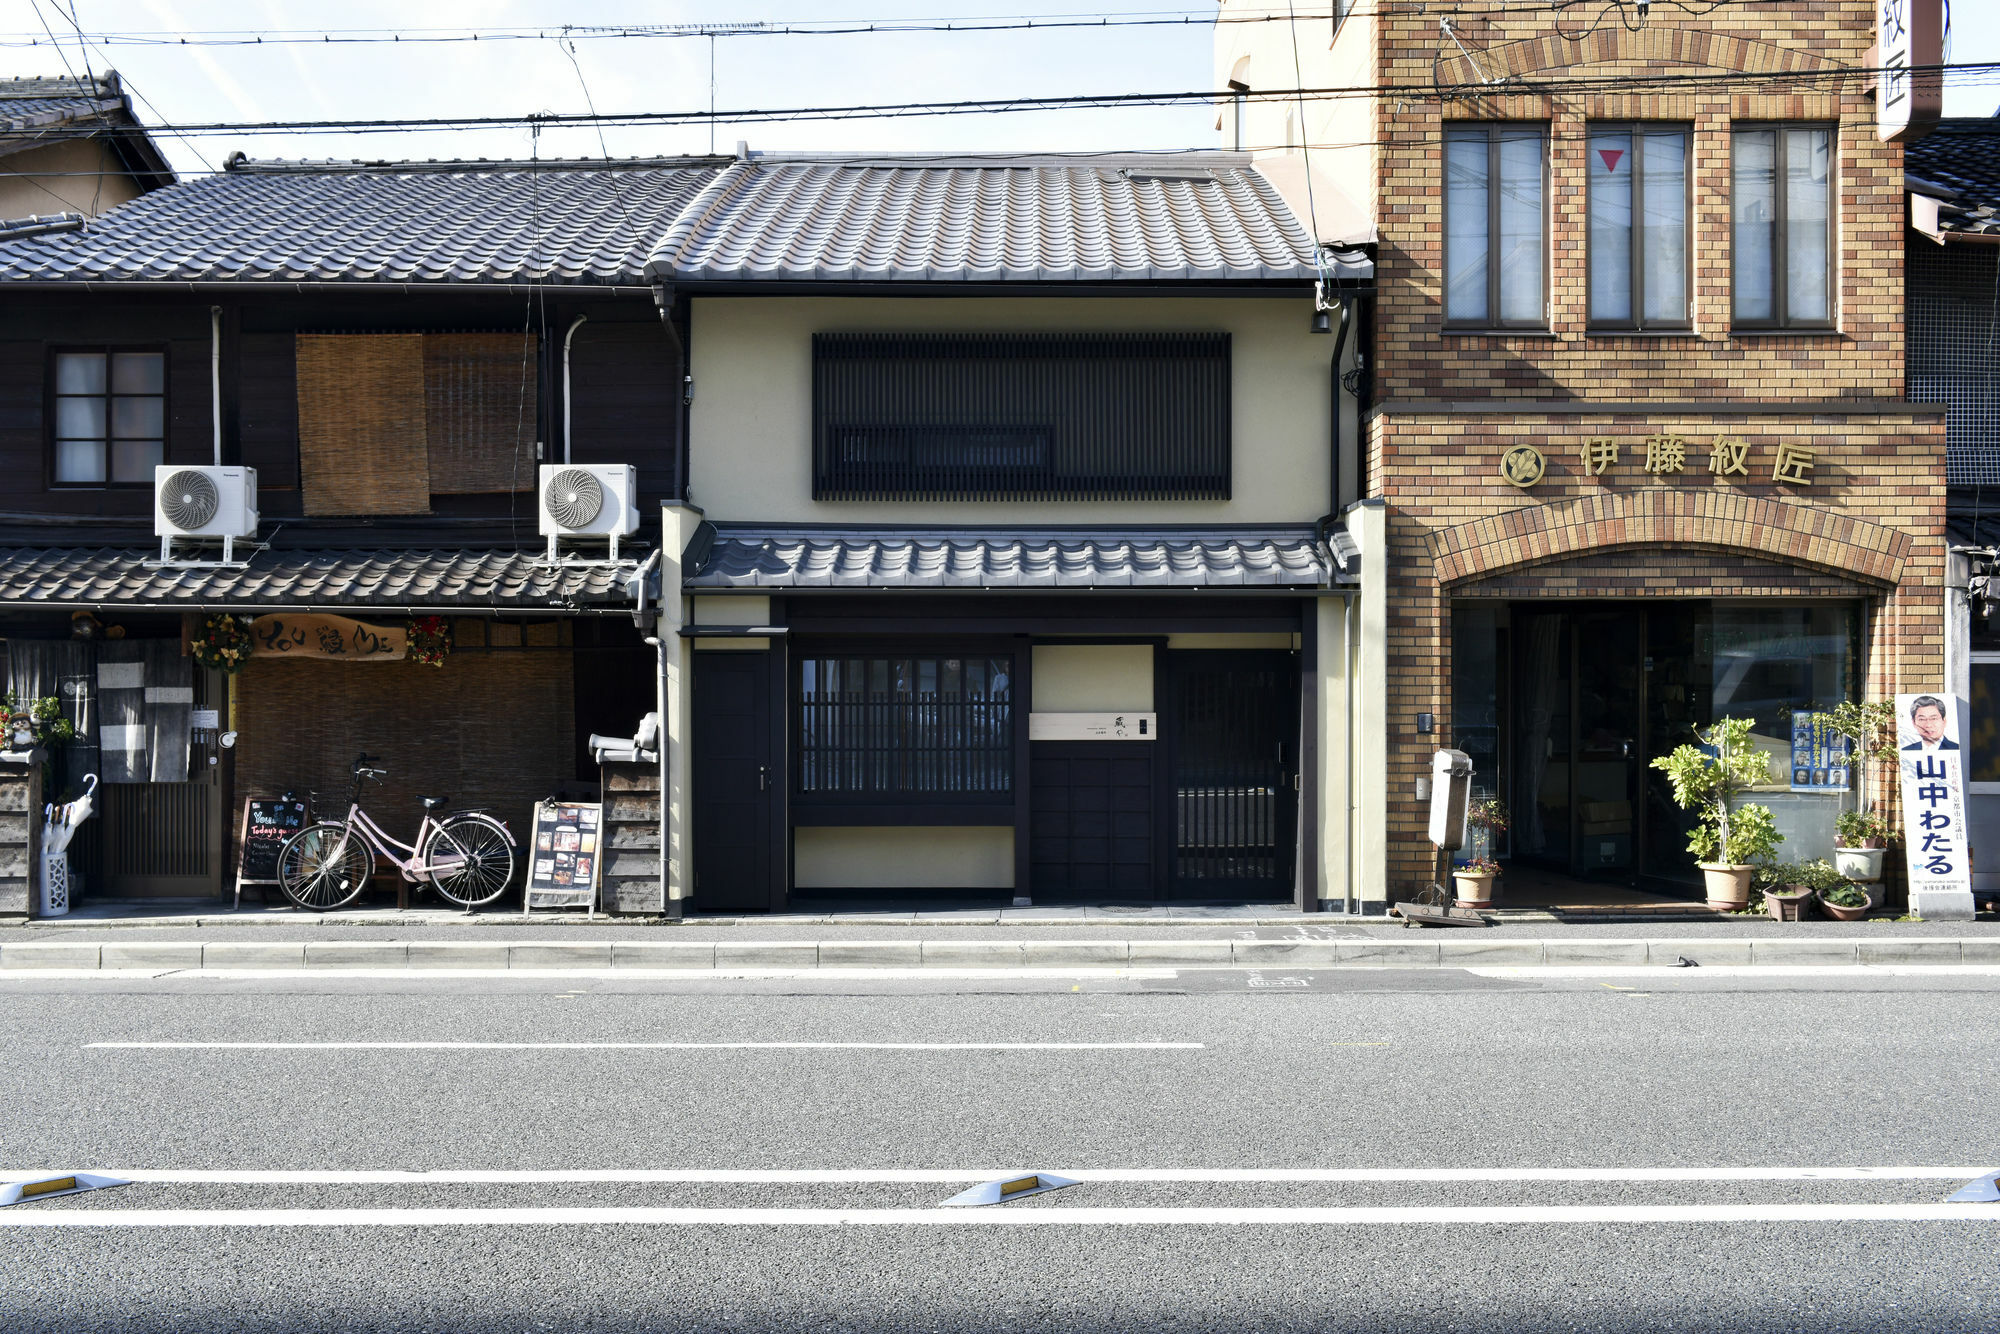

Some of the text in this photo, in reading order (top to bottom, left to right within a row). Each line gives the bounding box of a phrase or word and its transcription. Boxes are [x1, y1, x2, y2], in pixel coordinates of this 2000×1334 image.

[1580, 433, 1816, 485] 伊藤紋匠
[251, 824, 277, 838] Today's
[1916, 755, 1953, 875] 山中わたる
